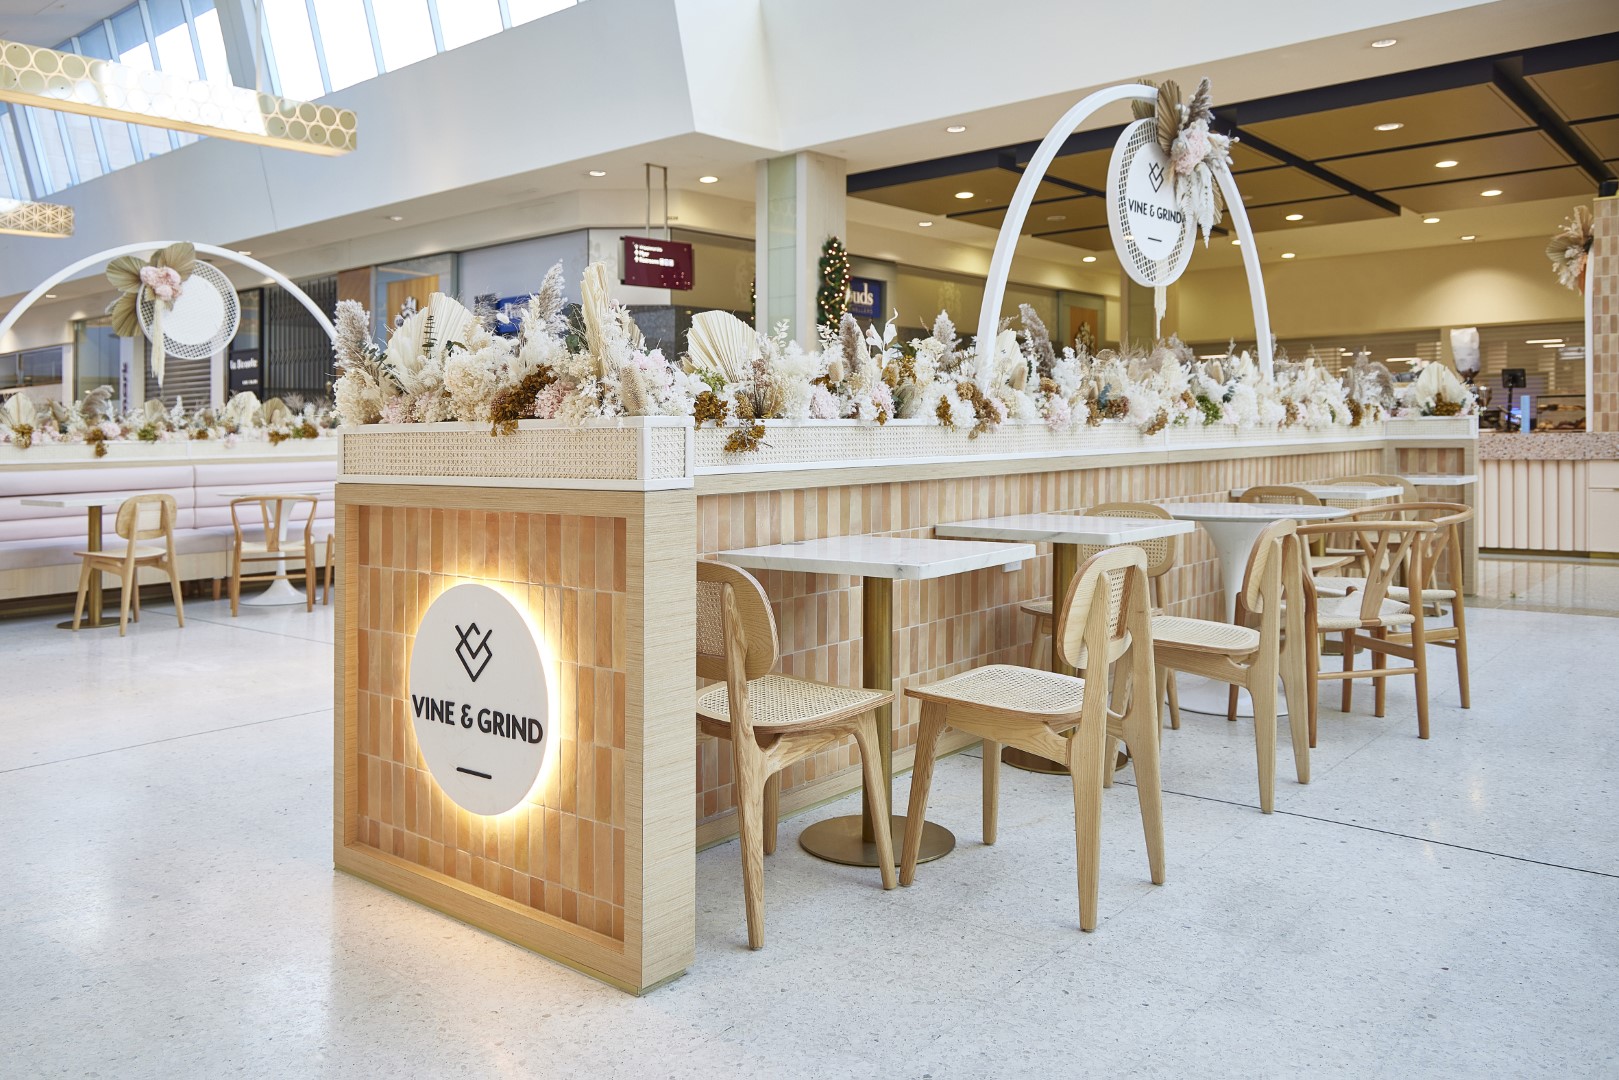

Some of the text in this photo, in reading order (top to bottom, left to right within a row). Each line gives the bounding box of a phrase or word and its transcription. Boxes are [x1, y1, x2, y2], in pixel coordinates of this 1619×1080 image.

[1128, 198, 1182, 224] VINE & GRIND
[850, 282, 874, 306] uds
[412, 694, 543, 744] VINE & GRIND
